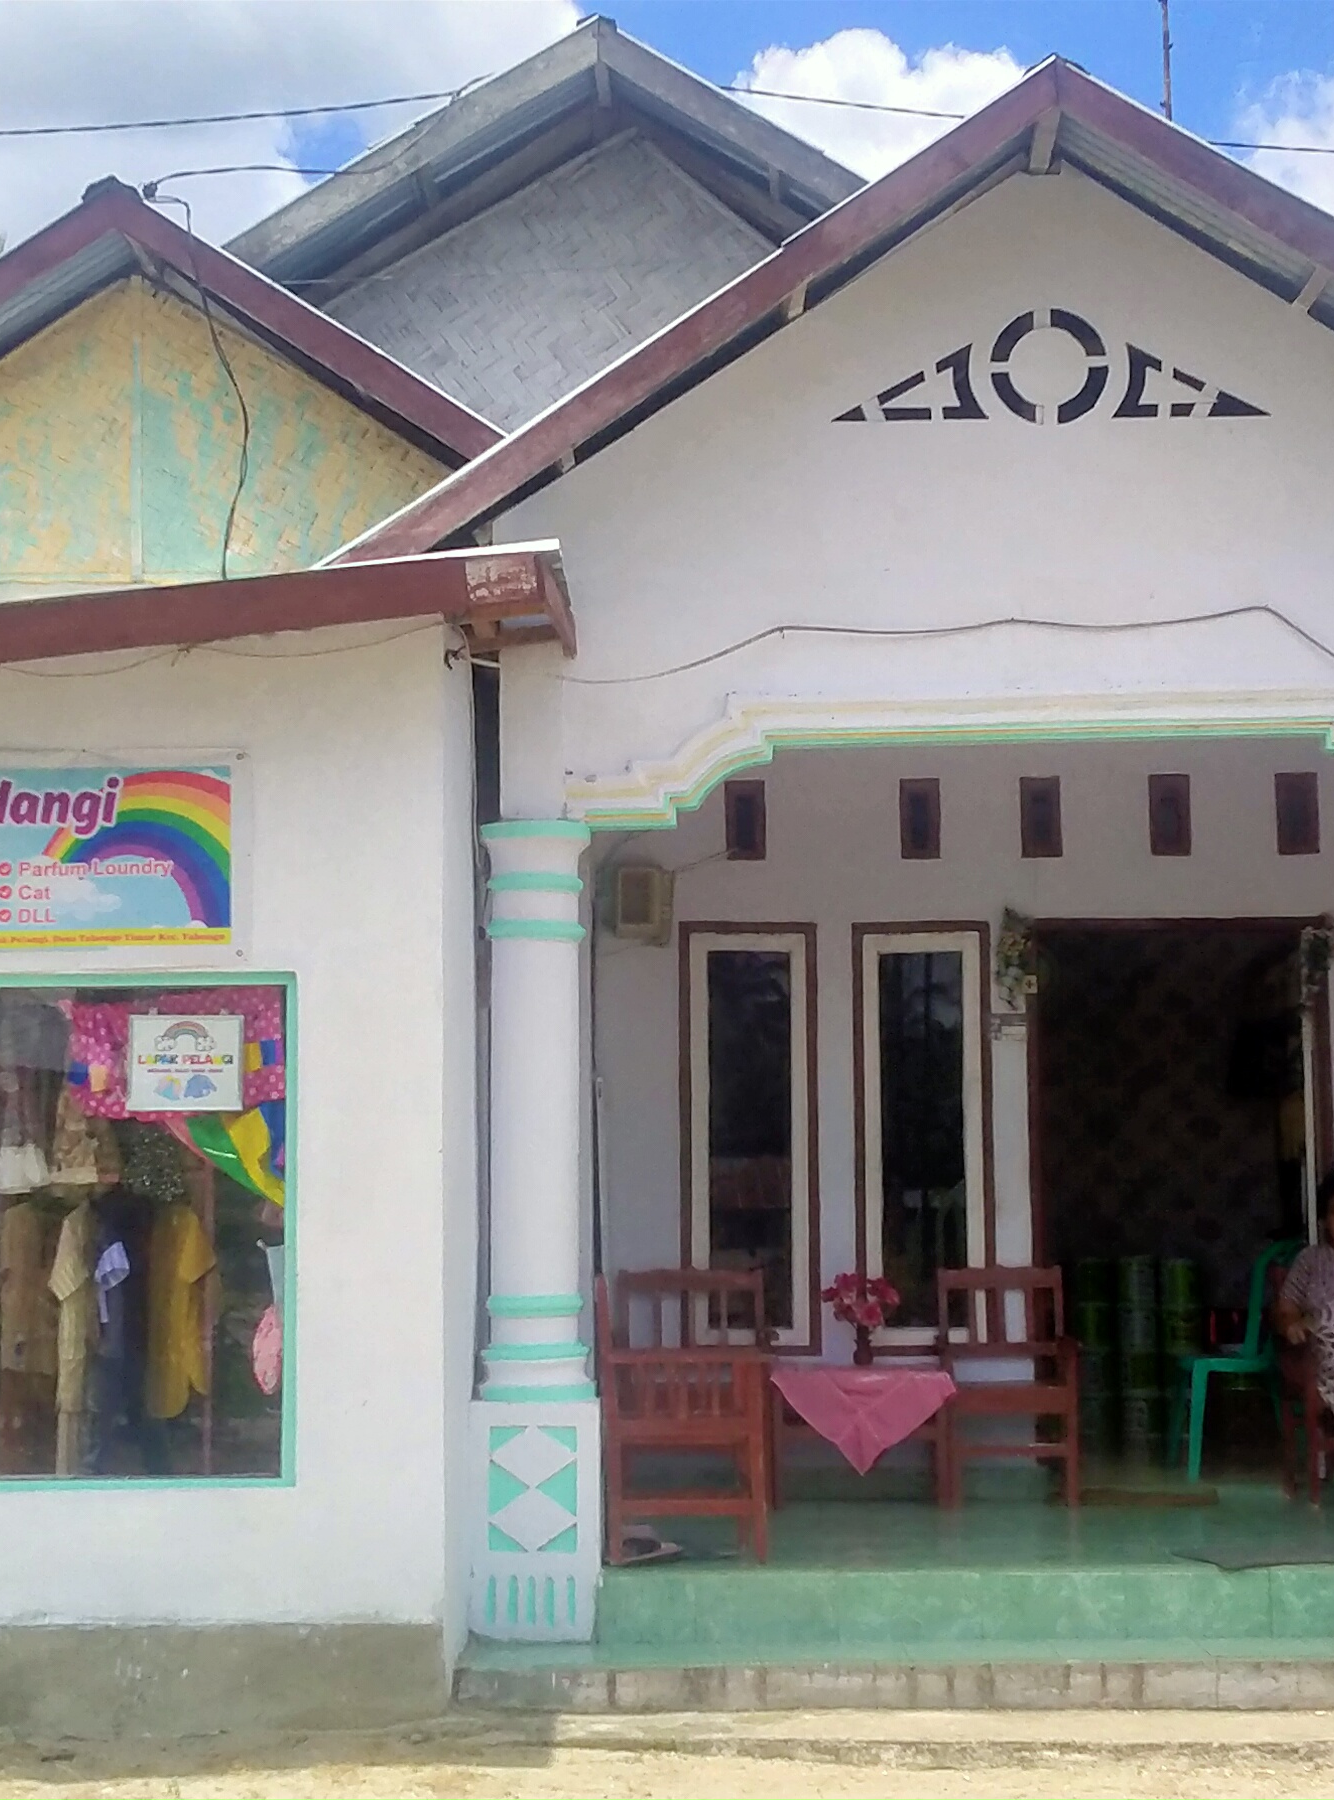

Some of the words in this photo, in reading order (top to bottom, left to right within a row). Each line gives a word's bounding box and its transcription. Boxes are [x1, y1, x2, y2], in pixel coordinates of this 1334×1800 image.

[18, 862, 87, 877] Parfum
[92, 859, 173, 877] Loundry
[18, 885, 51, 900] Cat
[18, 908, 56, 923] DLL
